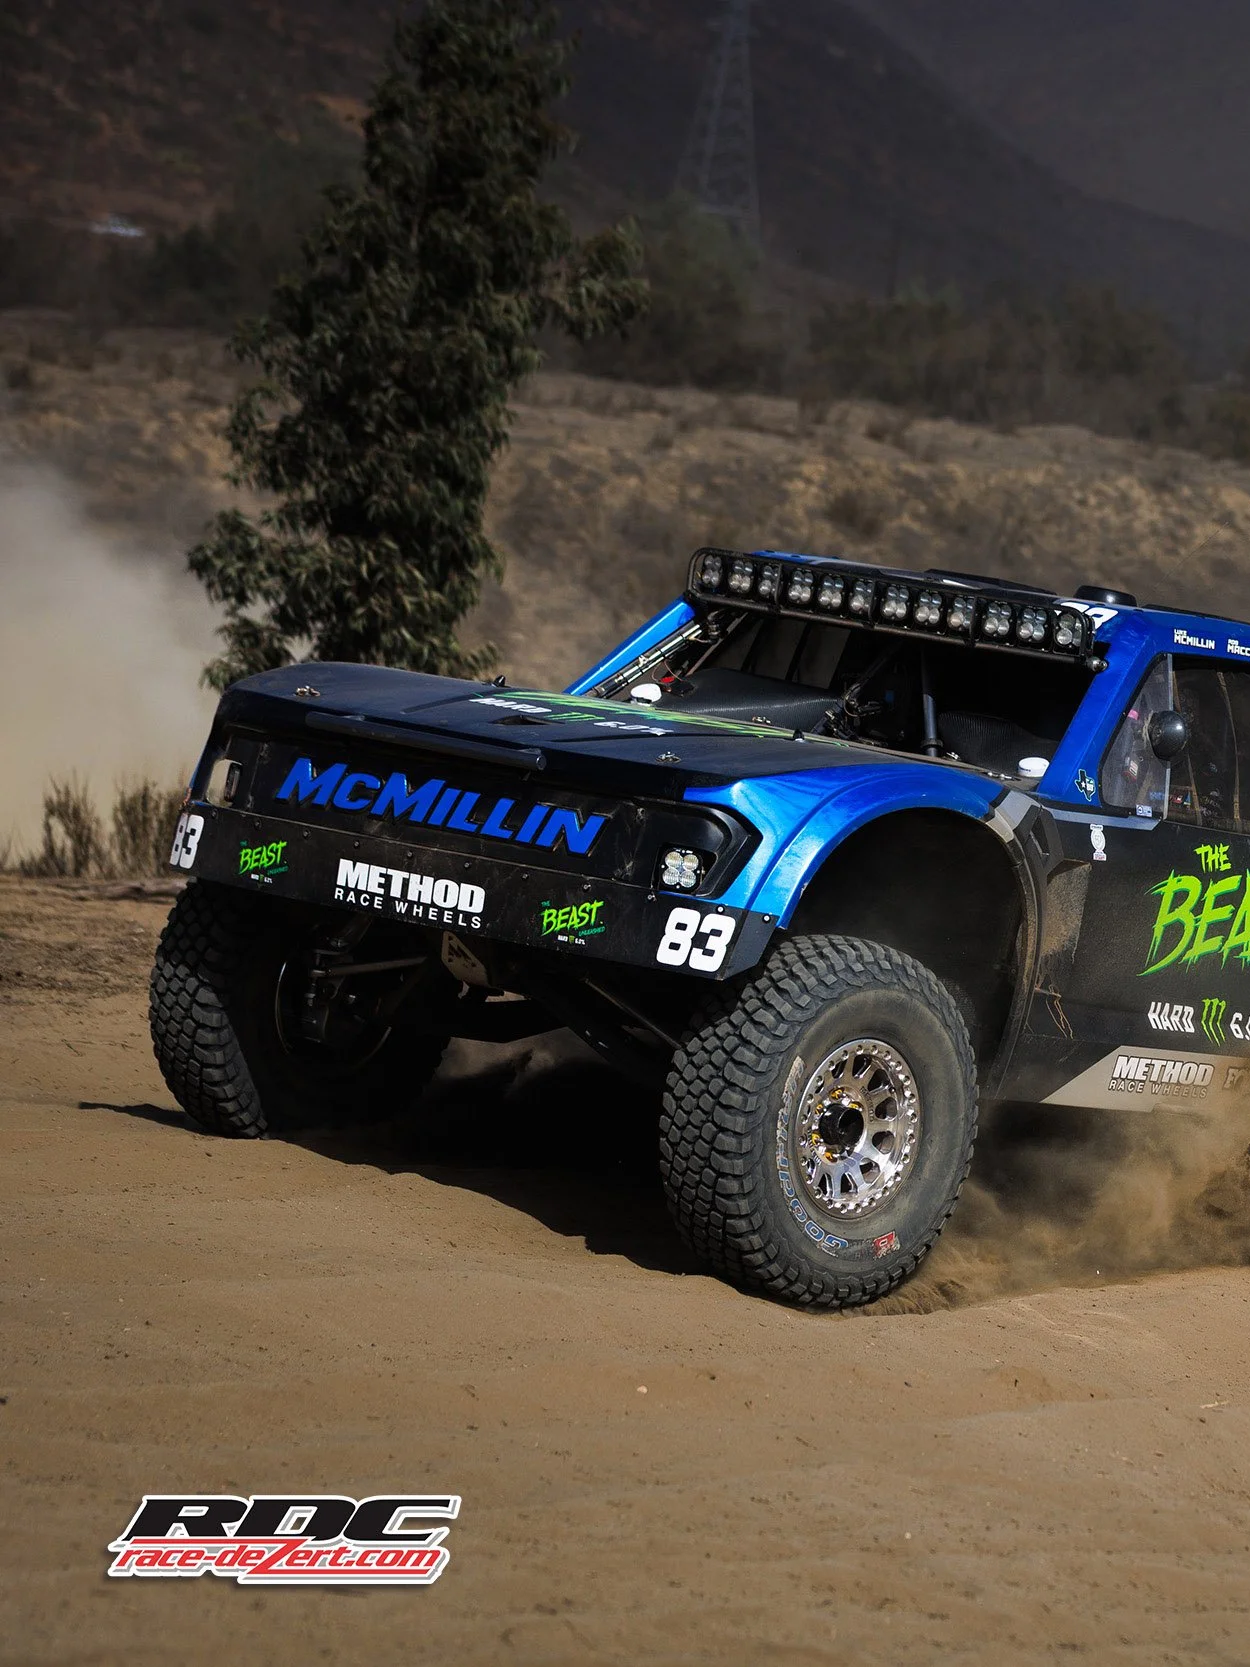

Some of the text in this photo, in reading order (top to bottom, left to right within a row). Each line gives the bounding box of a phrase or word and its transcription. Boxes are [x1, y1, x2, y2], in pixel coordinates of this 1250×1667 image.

[169, 811, 205, 869] 83
[238, 841, 288, 875] BEAST
[1194, 844, 1230, 872] THE
[336, 858, 486, 914] METHOD
[334, 887, 482, 929] RACE WHEELS
[541, 899, 604, 937] BEAST
[656, 907, 736, 972] 83
[1147, 1001, 1195, 1033] HARD
[1108, 1078, 1208, 1099] RACE WHEELS
[1112, 1055, 1214, 1087] METHOD
